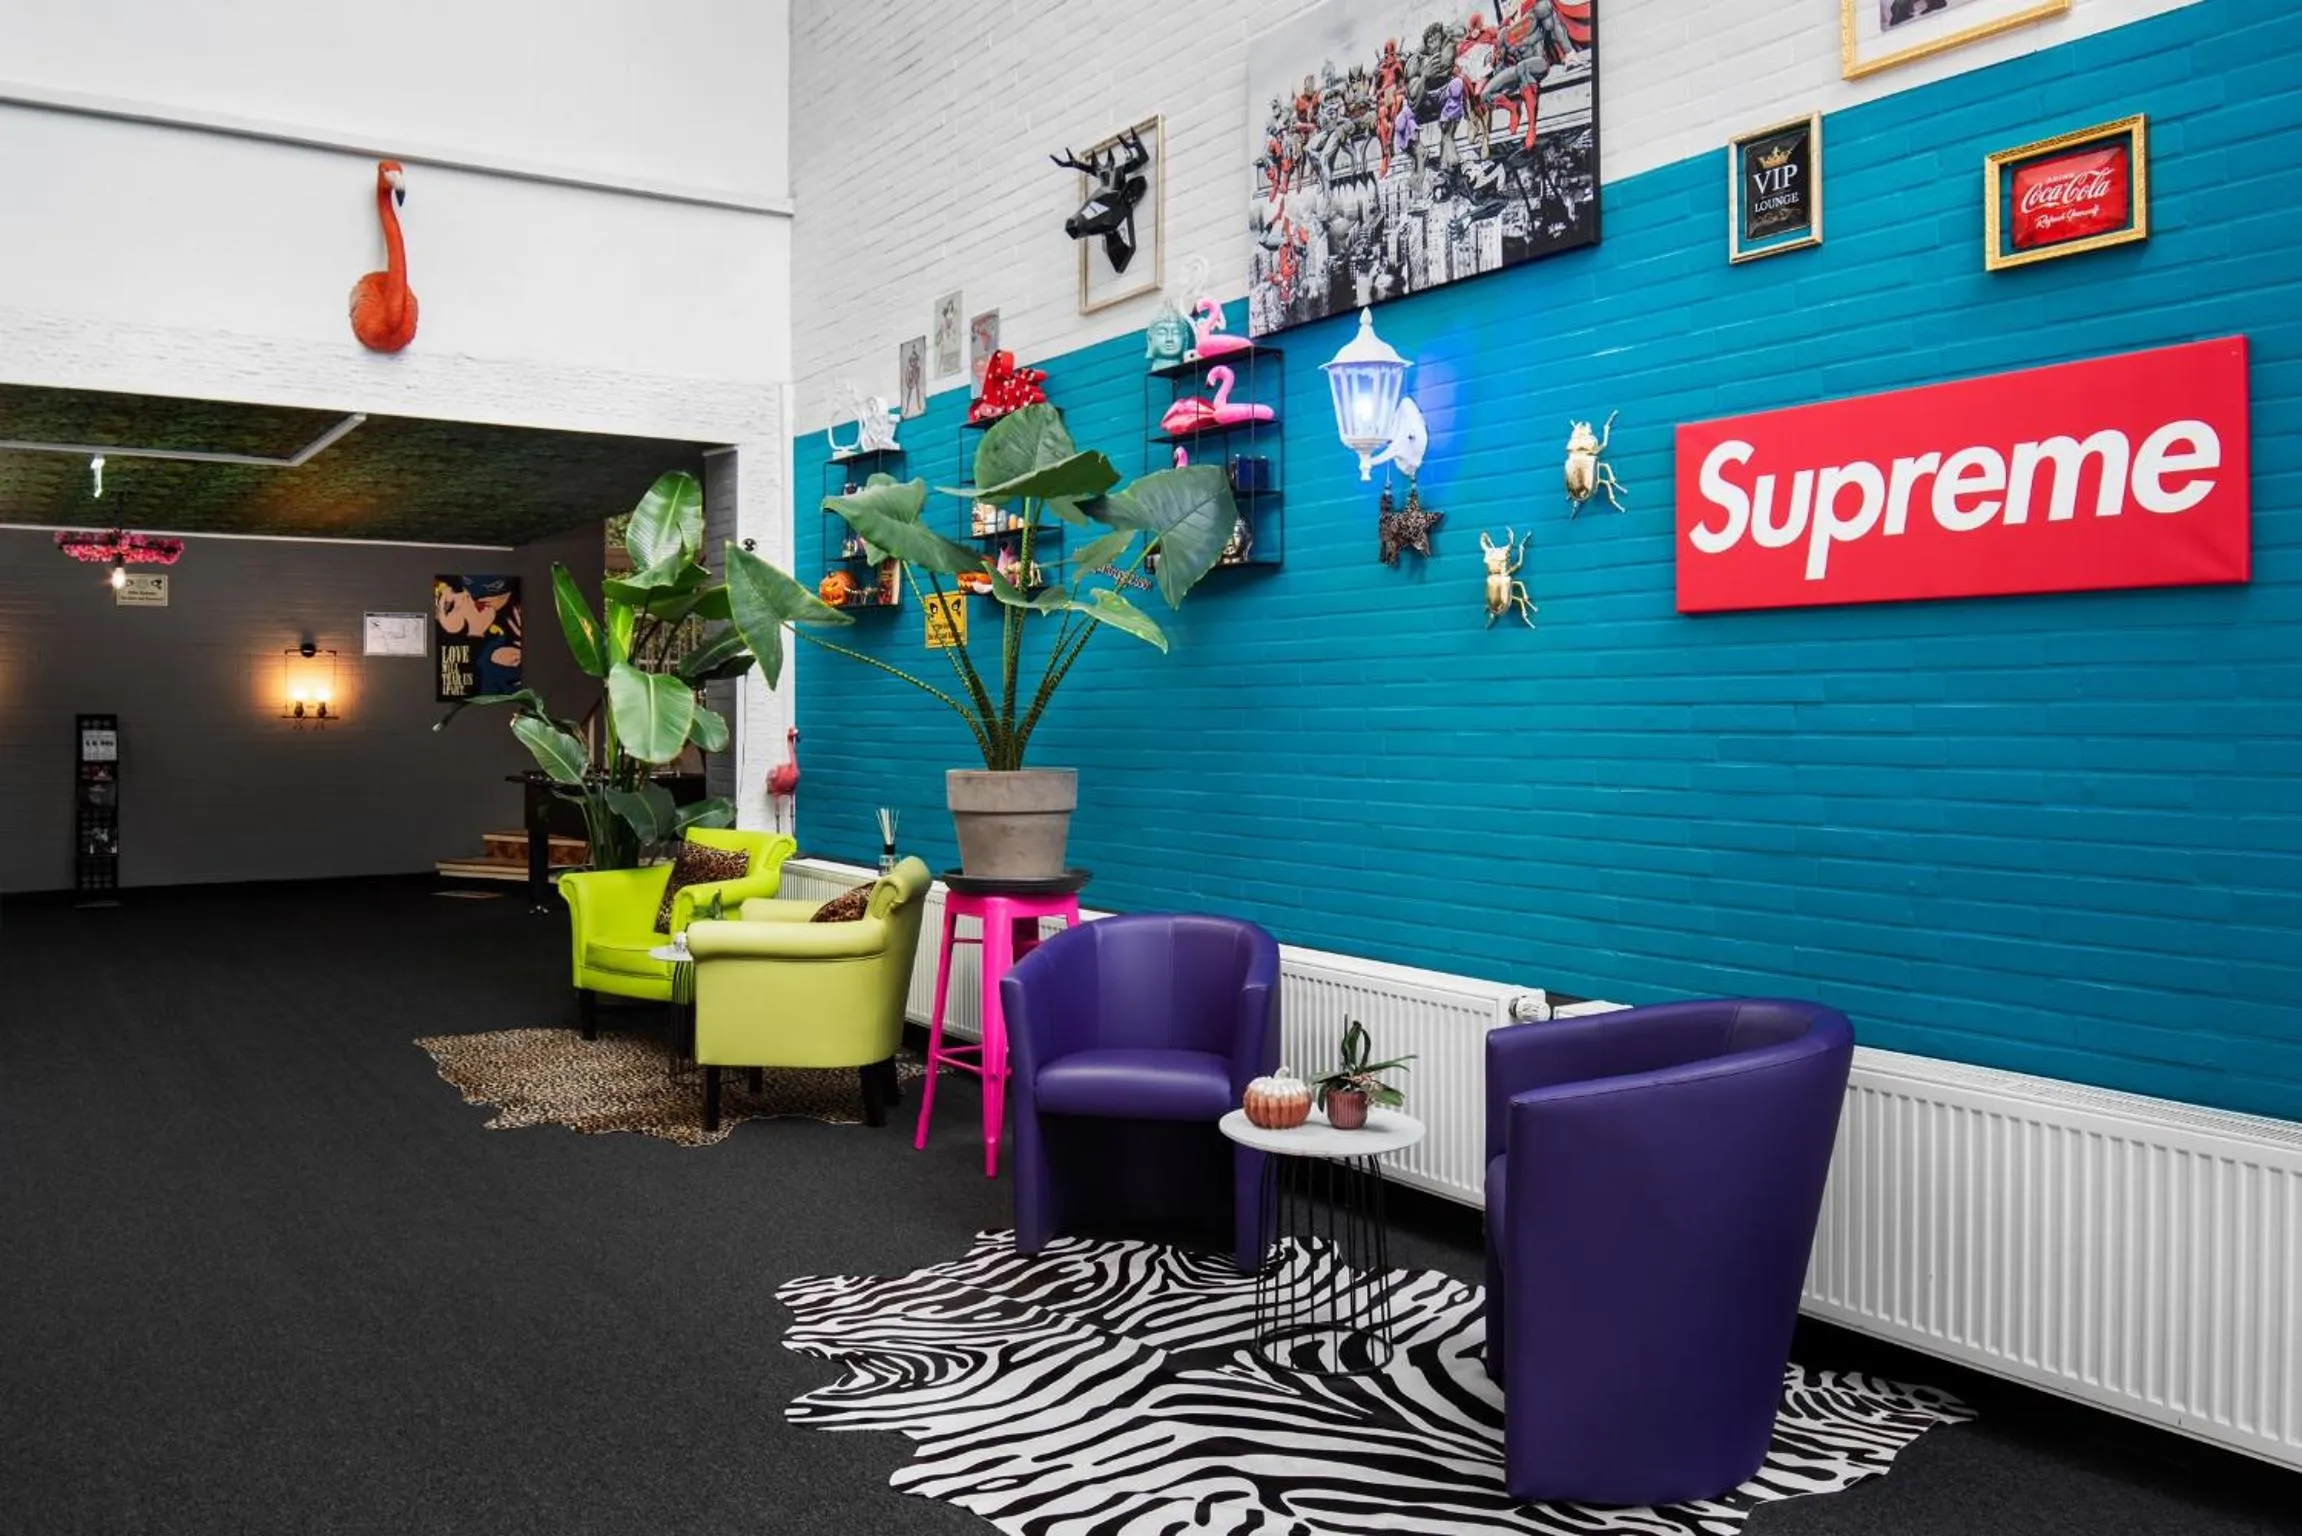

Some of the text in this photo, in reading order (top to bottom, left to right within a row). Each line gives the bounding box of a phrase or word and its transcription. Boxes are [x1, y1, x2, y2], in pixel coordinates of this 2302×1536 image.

[1753, 164, 1798, 195] VIP
[1755, 192, 1800, 213] LOUNGE
[1688, 419, 2221, 581] Supreme
[441, 645, 470, 663] LOVE
